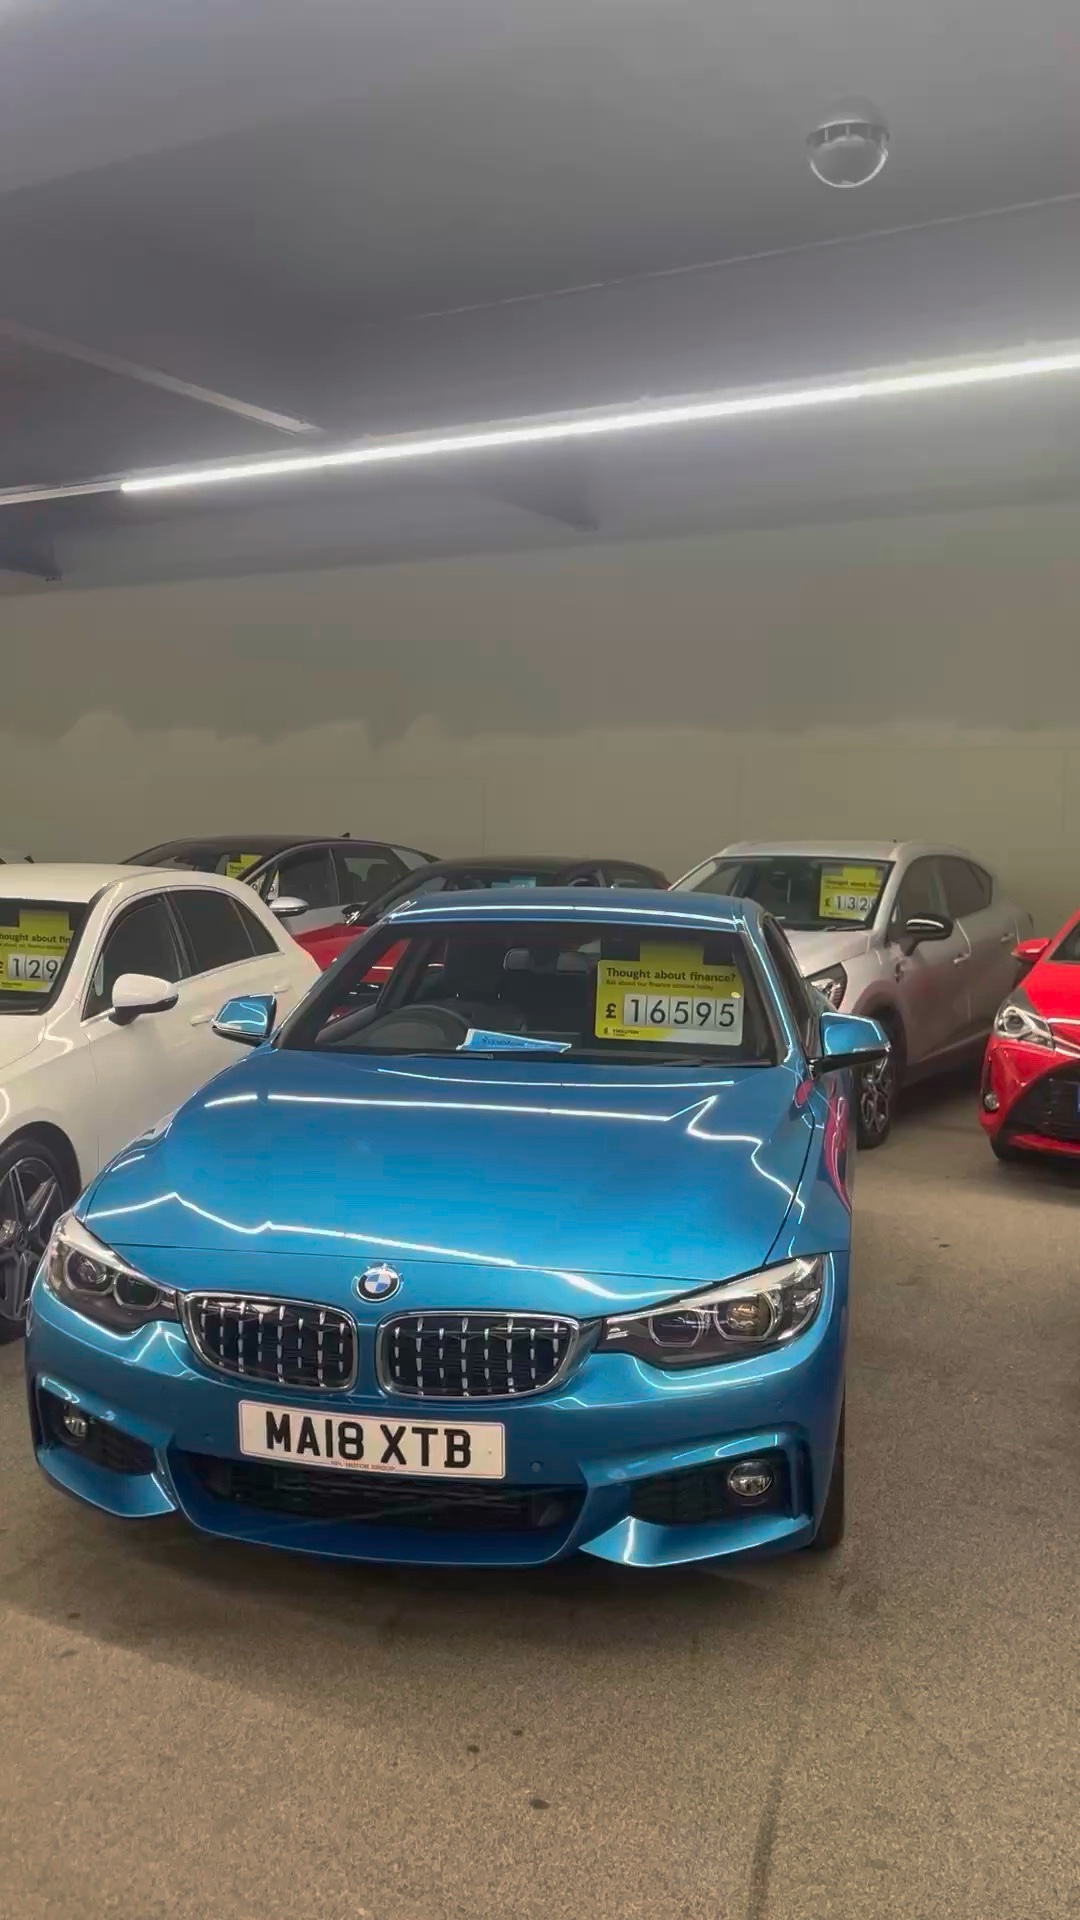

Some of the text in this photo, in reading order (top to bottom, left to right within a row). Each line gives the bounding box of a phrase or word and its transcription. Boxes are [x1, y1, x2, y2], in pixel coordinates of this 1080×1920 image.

[31, 934, 56, 943] about
[606, 967, 736, 983] Thought about finance?
[605, 998, 735, 1027] £ 16595
[265, 1410, 472, 1468] MA18 XTB
